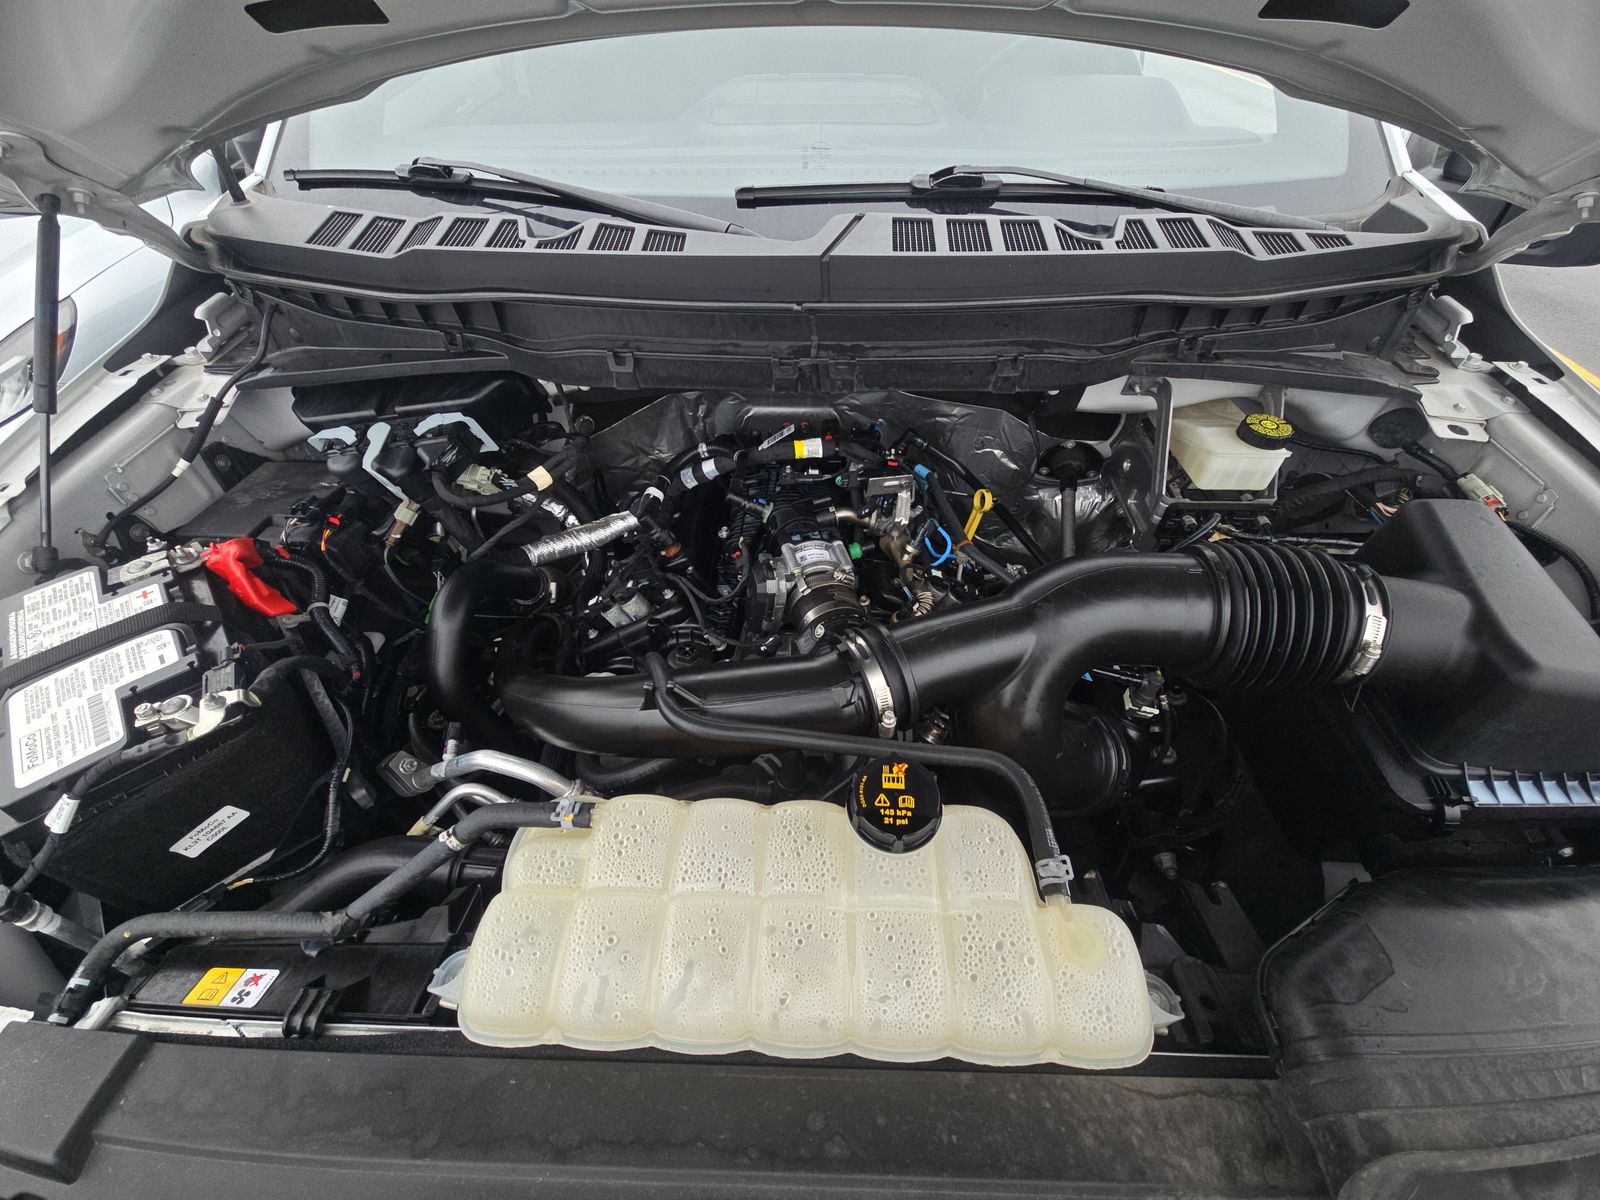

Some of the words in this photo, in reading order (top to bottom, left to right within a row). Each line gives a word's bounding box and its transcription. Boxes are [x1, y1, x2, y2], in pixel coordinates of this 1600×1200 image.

[24, 733, 39, 770] FoMoCo
[896, 809, 912, 817] kPa
[189, 818, 219, 840] FoMoCo
[896, 818, 908, 826] psi
